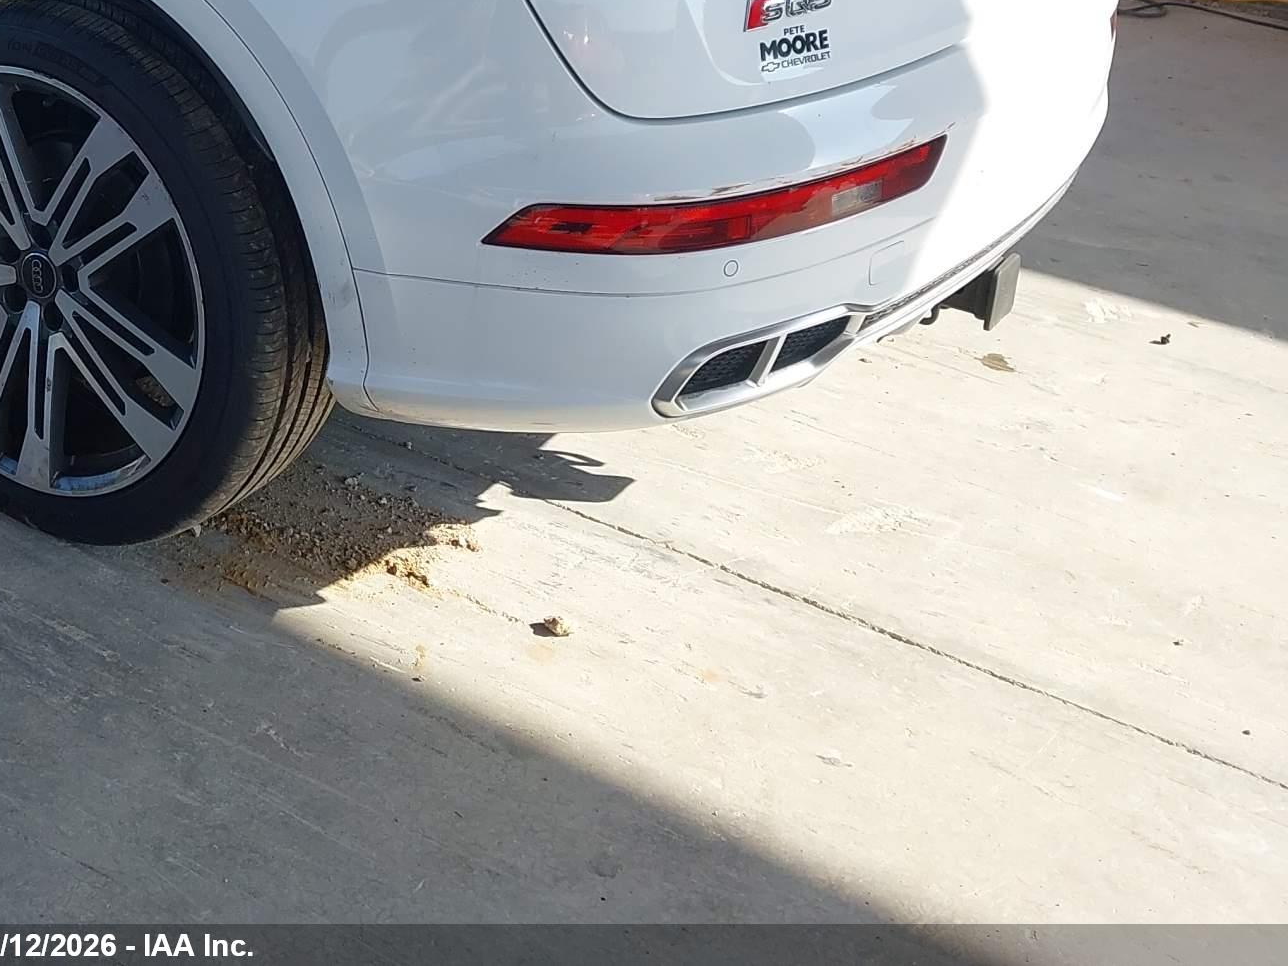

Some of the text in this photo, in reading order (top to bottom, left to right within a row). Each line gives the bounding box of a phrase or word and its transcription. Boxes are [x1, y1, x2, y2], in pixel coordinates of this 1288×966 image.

[783, 24, 805, 36] PETE
[759, 29, 830, 62] MOORE
[780, 50, 831, 69] CHEVROLET
